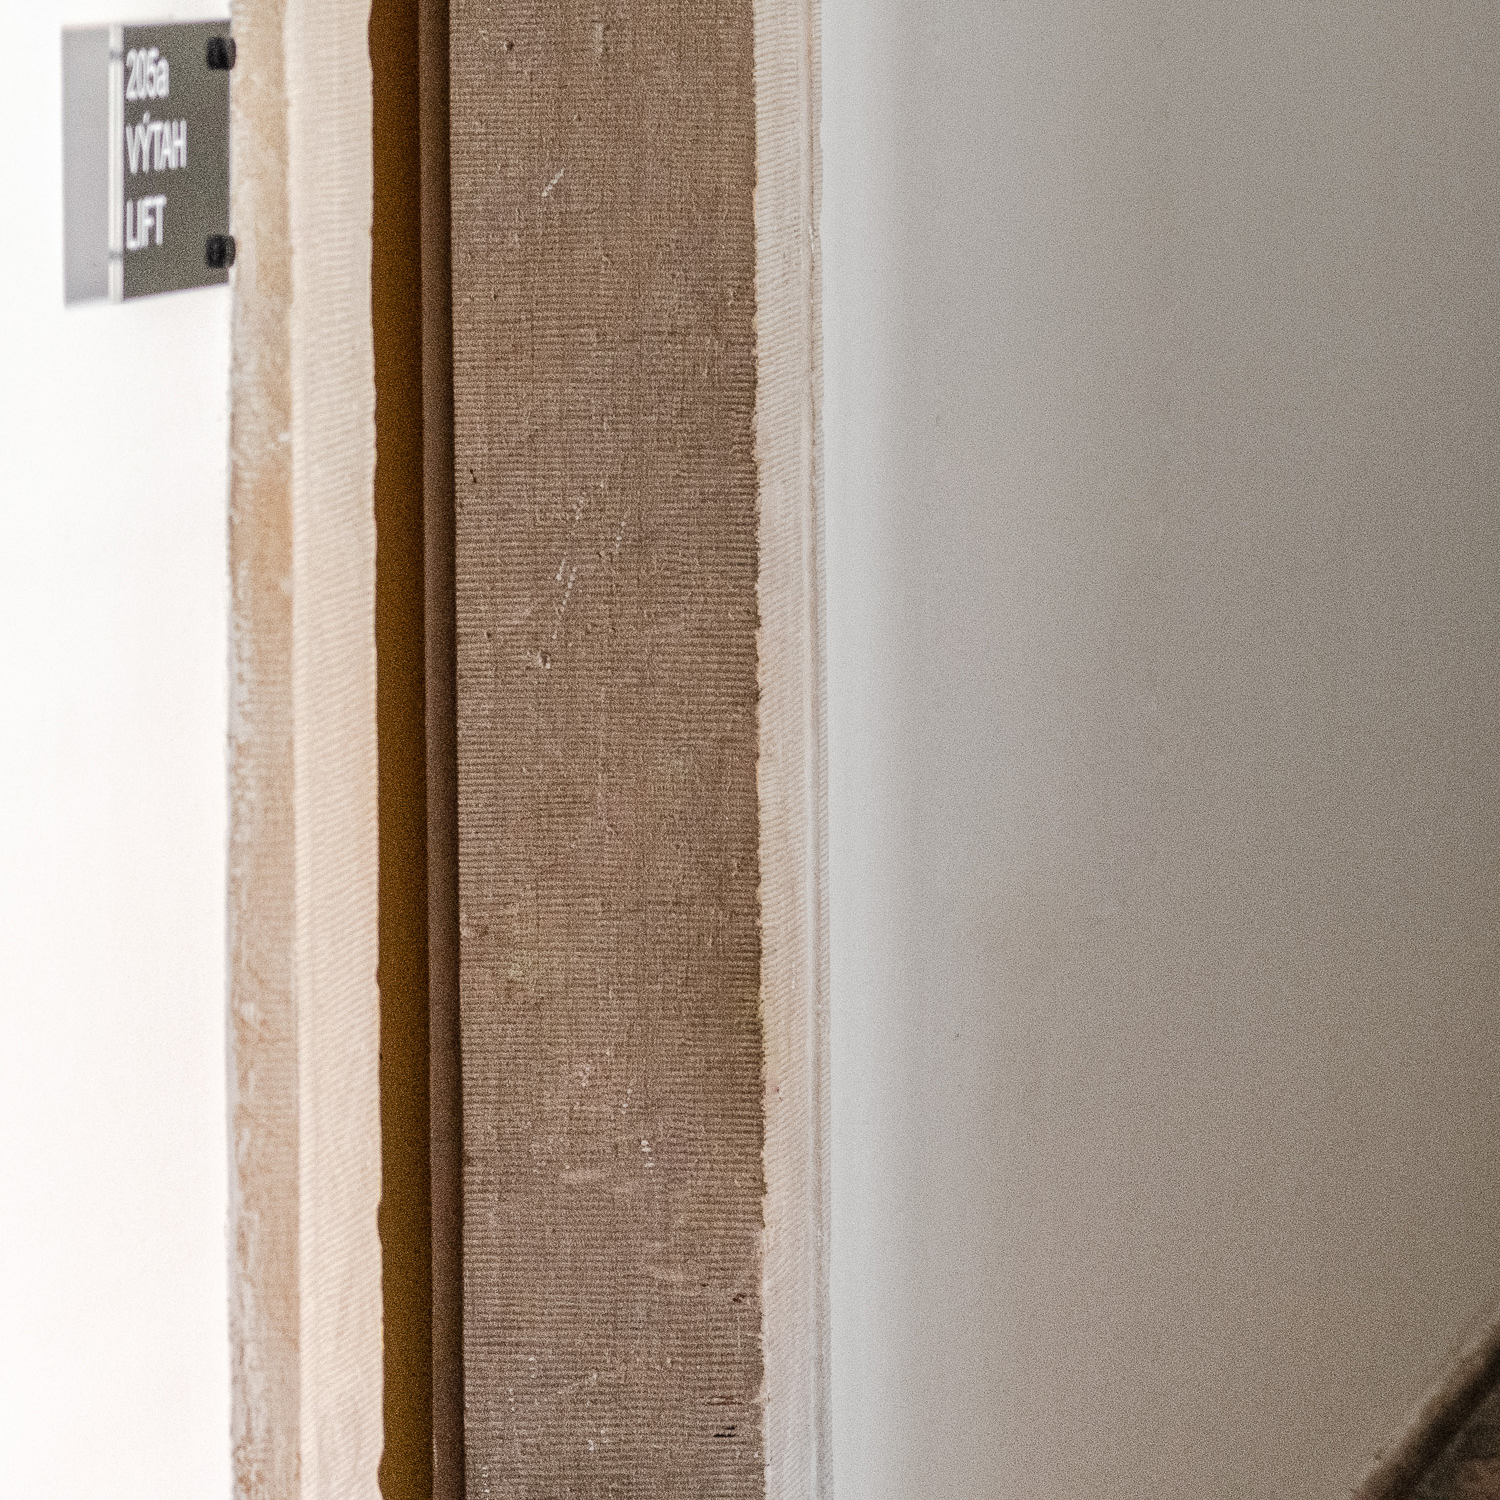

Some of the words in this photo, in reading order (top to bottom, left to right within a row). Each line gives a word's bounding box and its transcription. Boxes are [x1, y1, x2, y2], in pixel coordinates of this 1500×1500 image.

[125, 47, 171, 101] 205a
[125, 110, 188, 175] VÝTAH
[125, 195, 167, 251] LIFT
